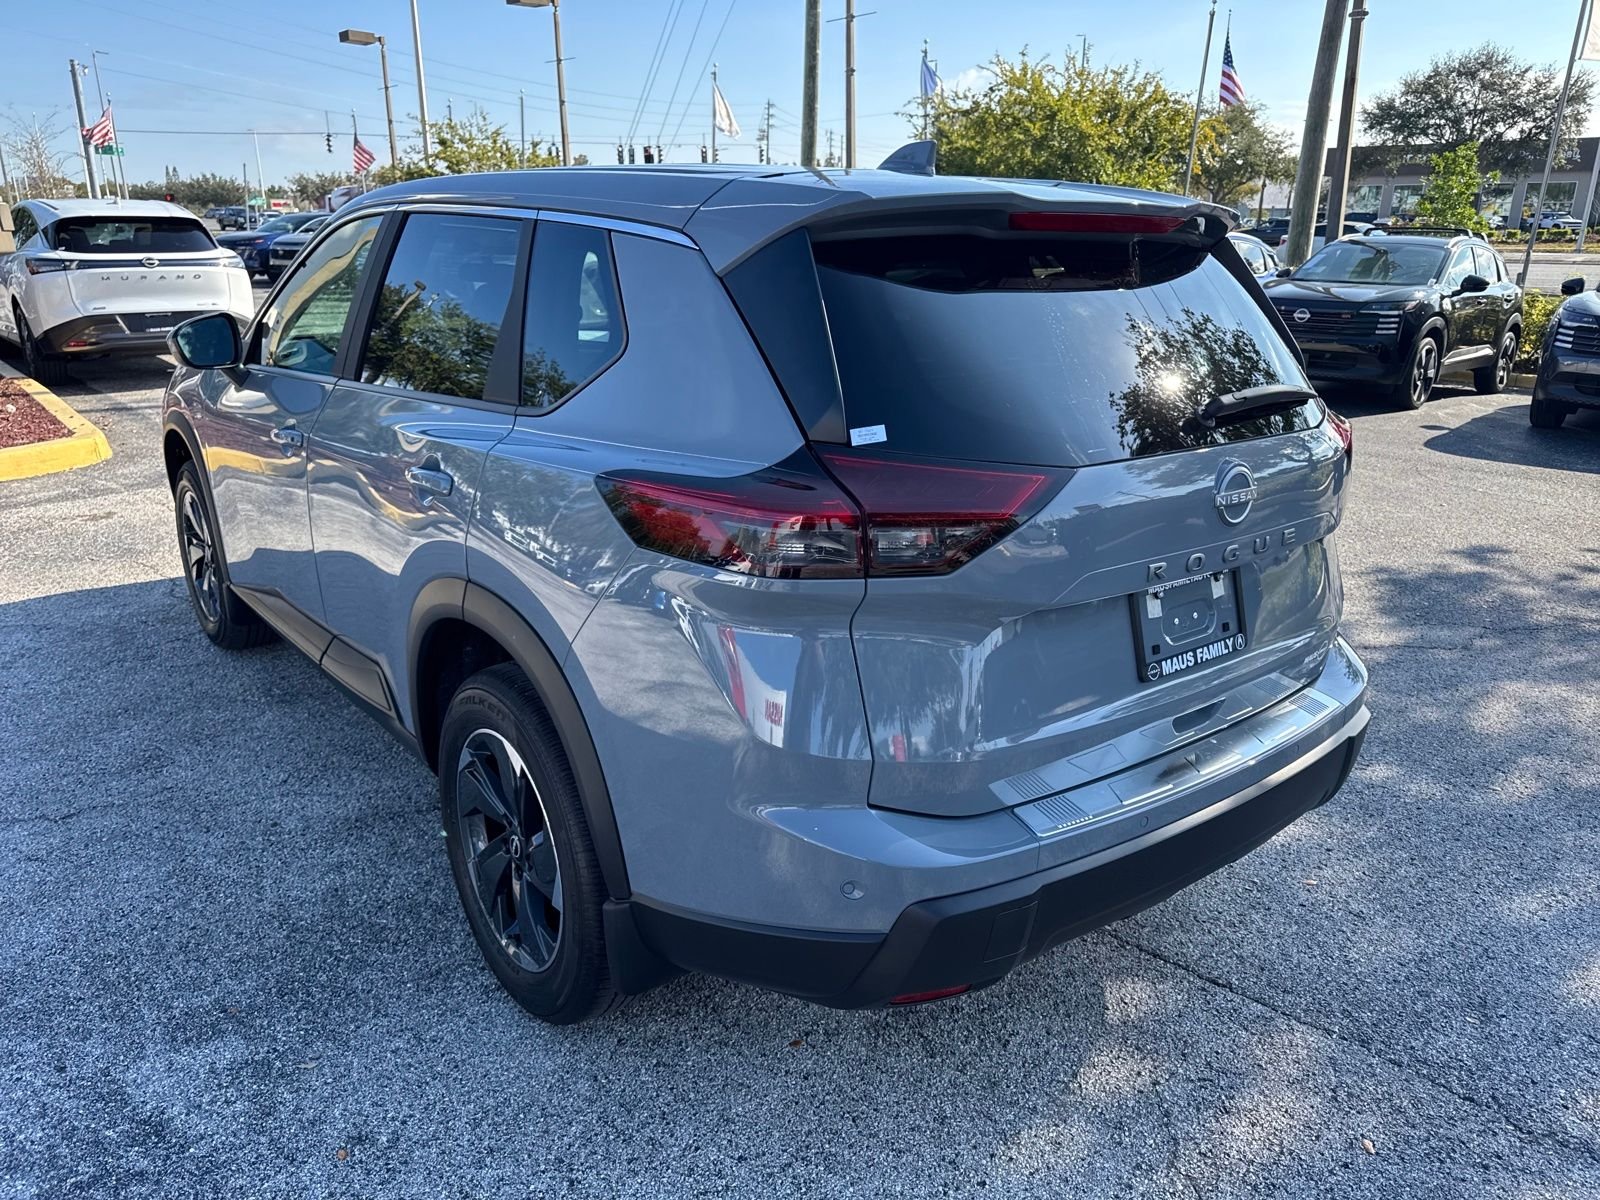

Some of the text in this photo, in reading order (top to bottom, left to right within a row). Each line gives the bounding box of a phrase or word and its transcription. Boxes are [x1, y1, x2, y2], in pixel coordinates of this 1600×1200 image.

[1216, 489, 1258, 506] NISSAN
[1147, 529, 1296, 580] ROGUE
[1161, 637, 1235, 676] MAUS FAMILY
